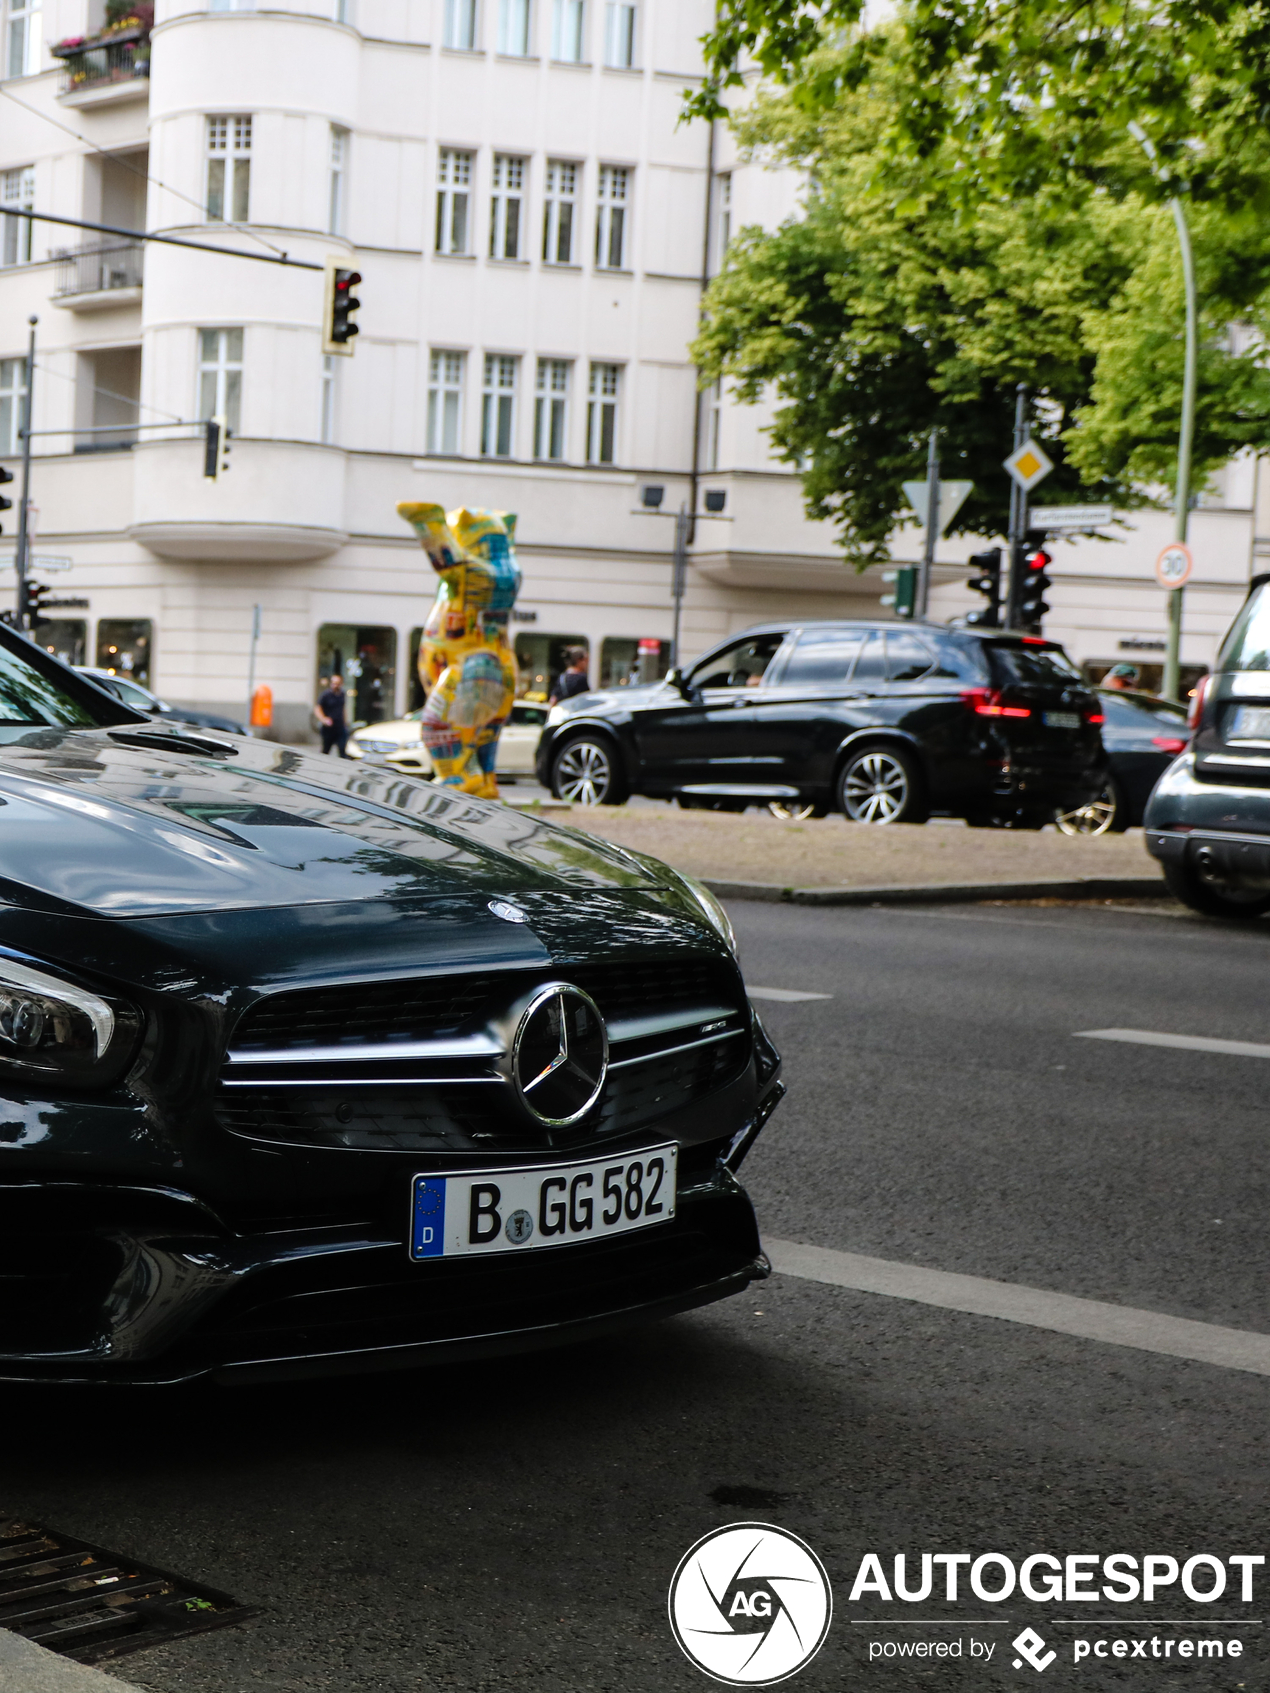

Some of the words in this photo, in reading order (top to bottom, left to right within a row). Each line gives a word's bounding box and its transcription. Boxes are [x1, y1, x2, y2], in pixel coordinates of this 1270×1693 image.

[1162, 555, 1184, 576] 30
[468, 1182, 502, 1244] B
[422, 1227, 434, 1244] D
